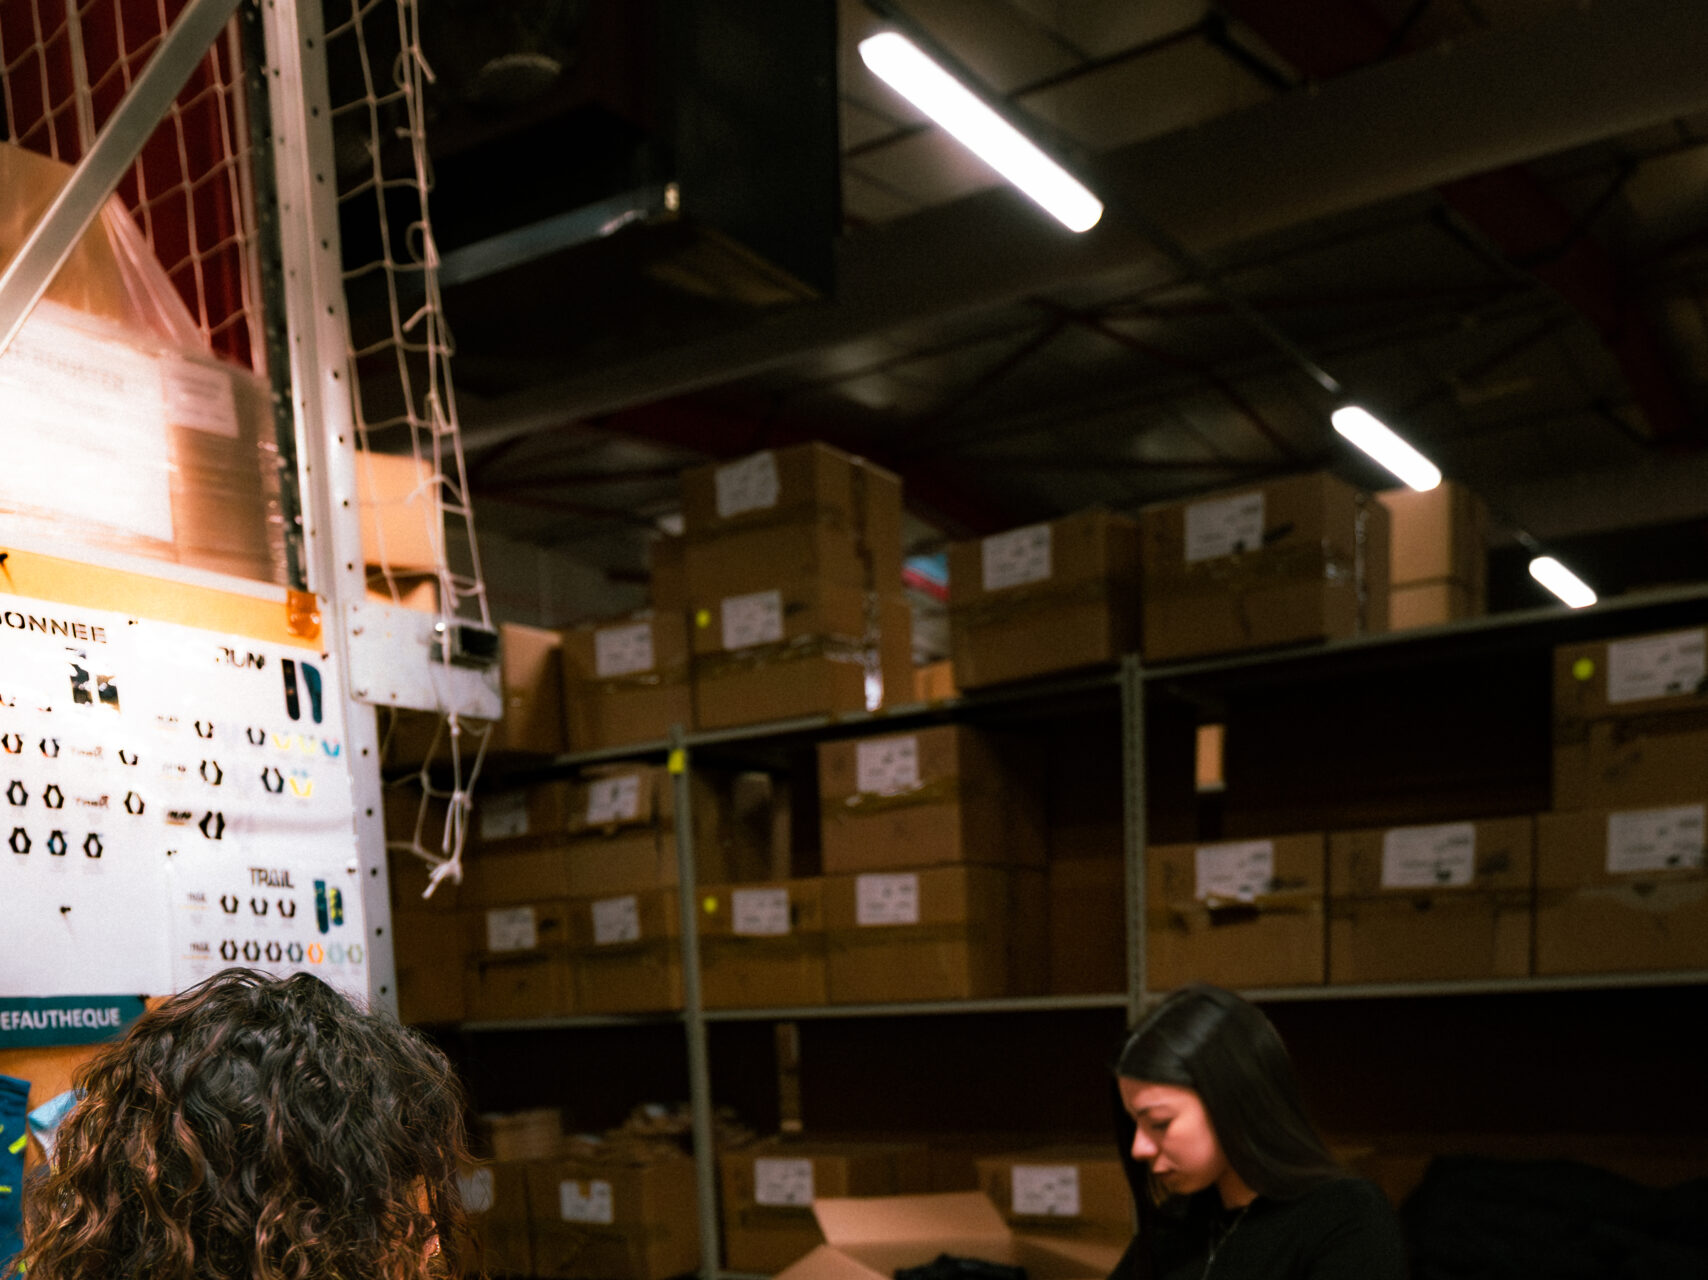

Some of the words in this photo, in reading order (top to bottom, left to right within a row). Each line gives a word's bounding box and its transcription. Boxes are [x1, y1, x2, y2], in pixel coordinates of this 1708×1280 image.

[0, 611, 107, 644] ONNEE
[249, 866, 295, 888] TRAIL
[0, 1007, 121, 1031] EFAUTHEQUE
